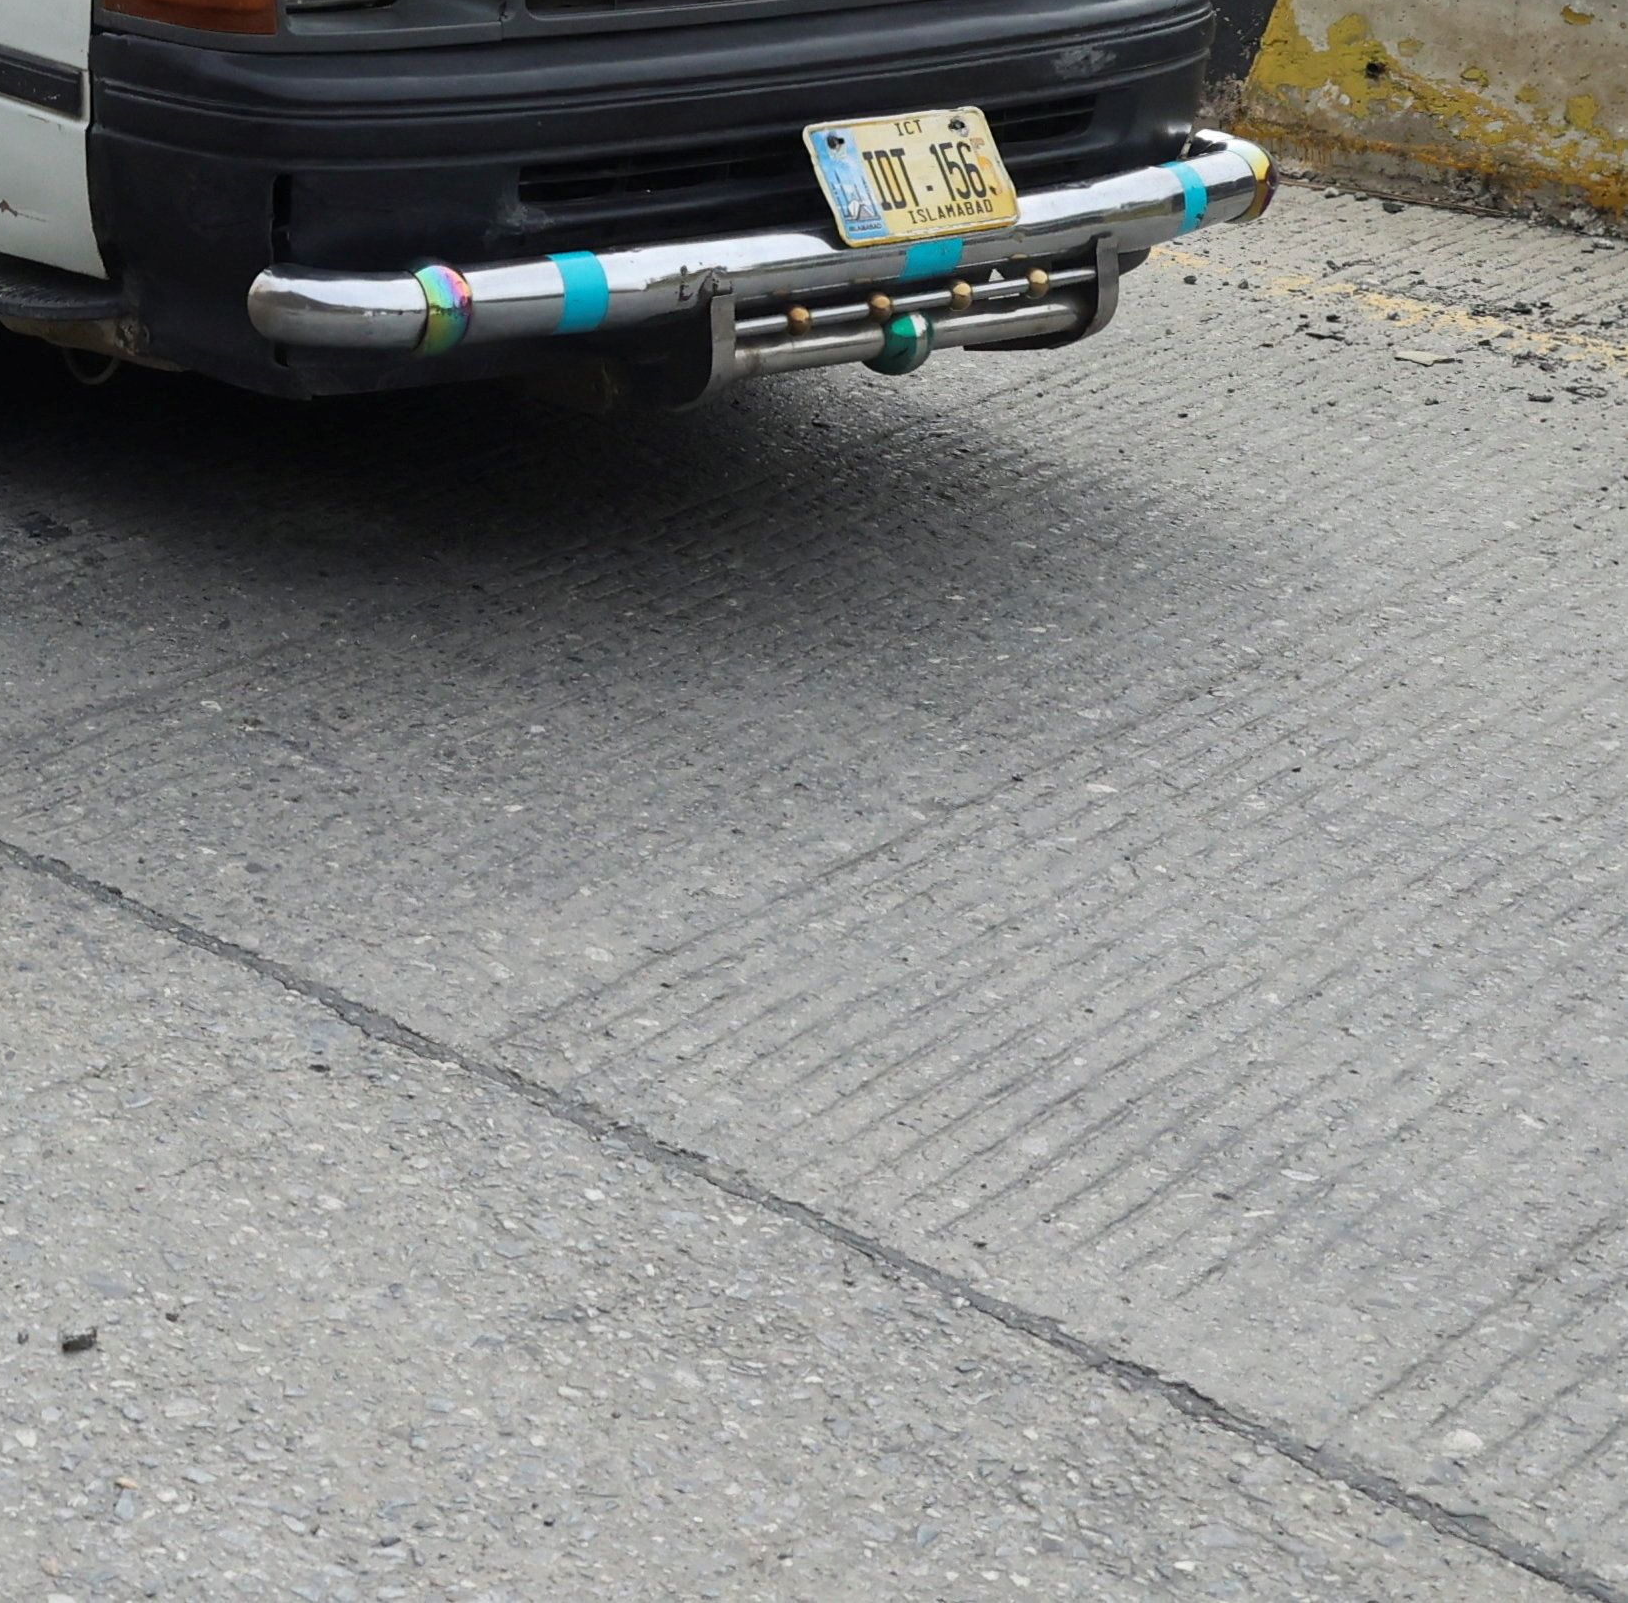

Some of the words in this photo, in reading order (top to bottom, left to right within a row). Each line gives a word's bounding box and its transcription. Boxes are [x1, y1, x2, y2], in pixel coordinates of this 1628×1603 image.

[894, 119, 924, 137] ICT
[863, 148, 920, 211] IDT
[909, 199, 994, 225] ISLAMABAD
